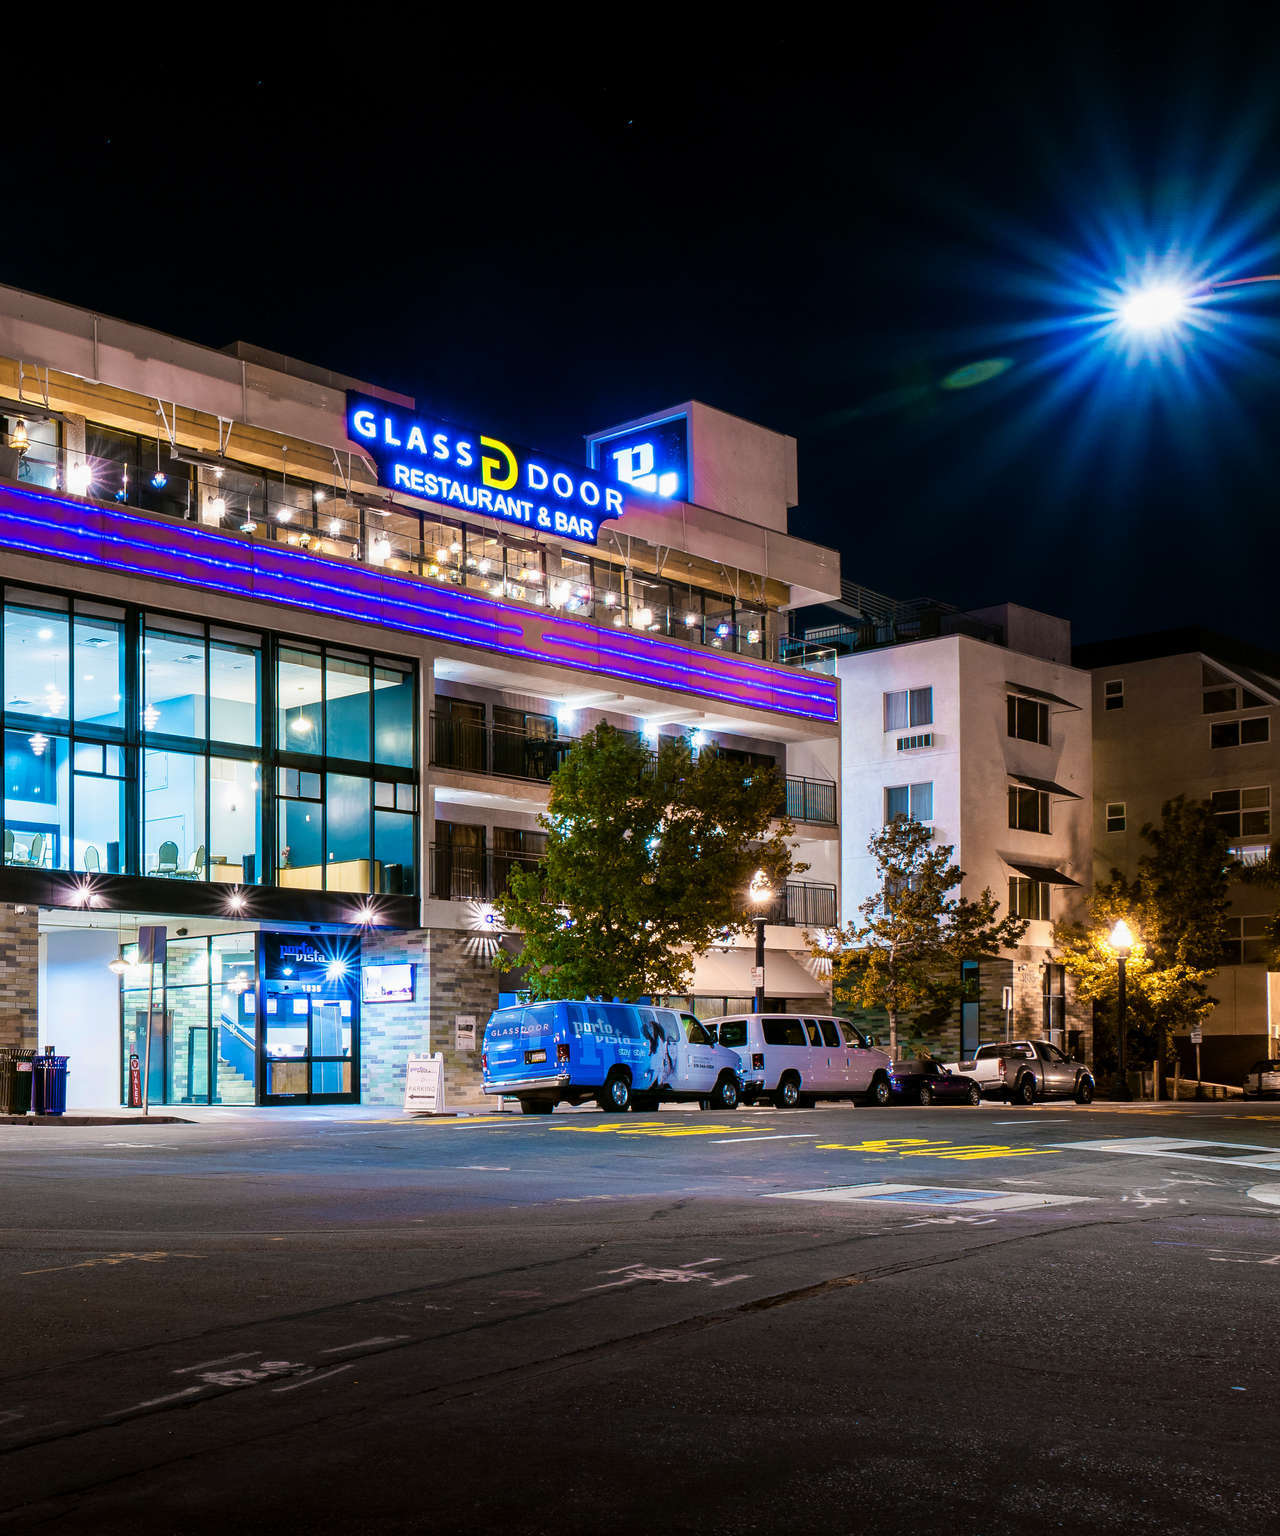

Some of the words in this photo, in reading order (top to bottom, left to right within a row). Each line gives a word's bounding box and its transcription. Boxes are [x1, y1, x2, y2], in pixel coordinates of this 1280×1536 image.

[353, 411, 473, 466] GLASS
[528, 464, 624, 515] DOOR
[395, 464, 534, 521] RESTAURANT
[538, 508, 552, 526] &
[555, 511, 594, 538] BAR
[279, 941, 314, 959] porto
[293, 949, 326, 963] vista
[572, 1018, 613, 1038] porto
[595, 1029, 631, 1045] vista
